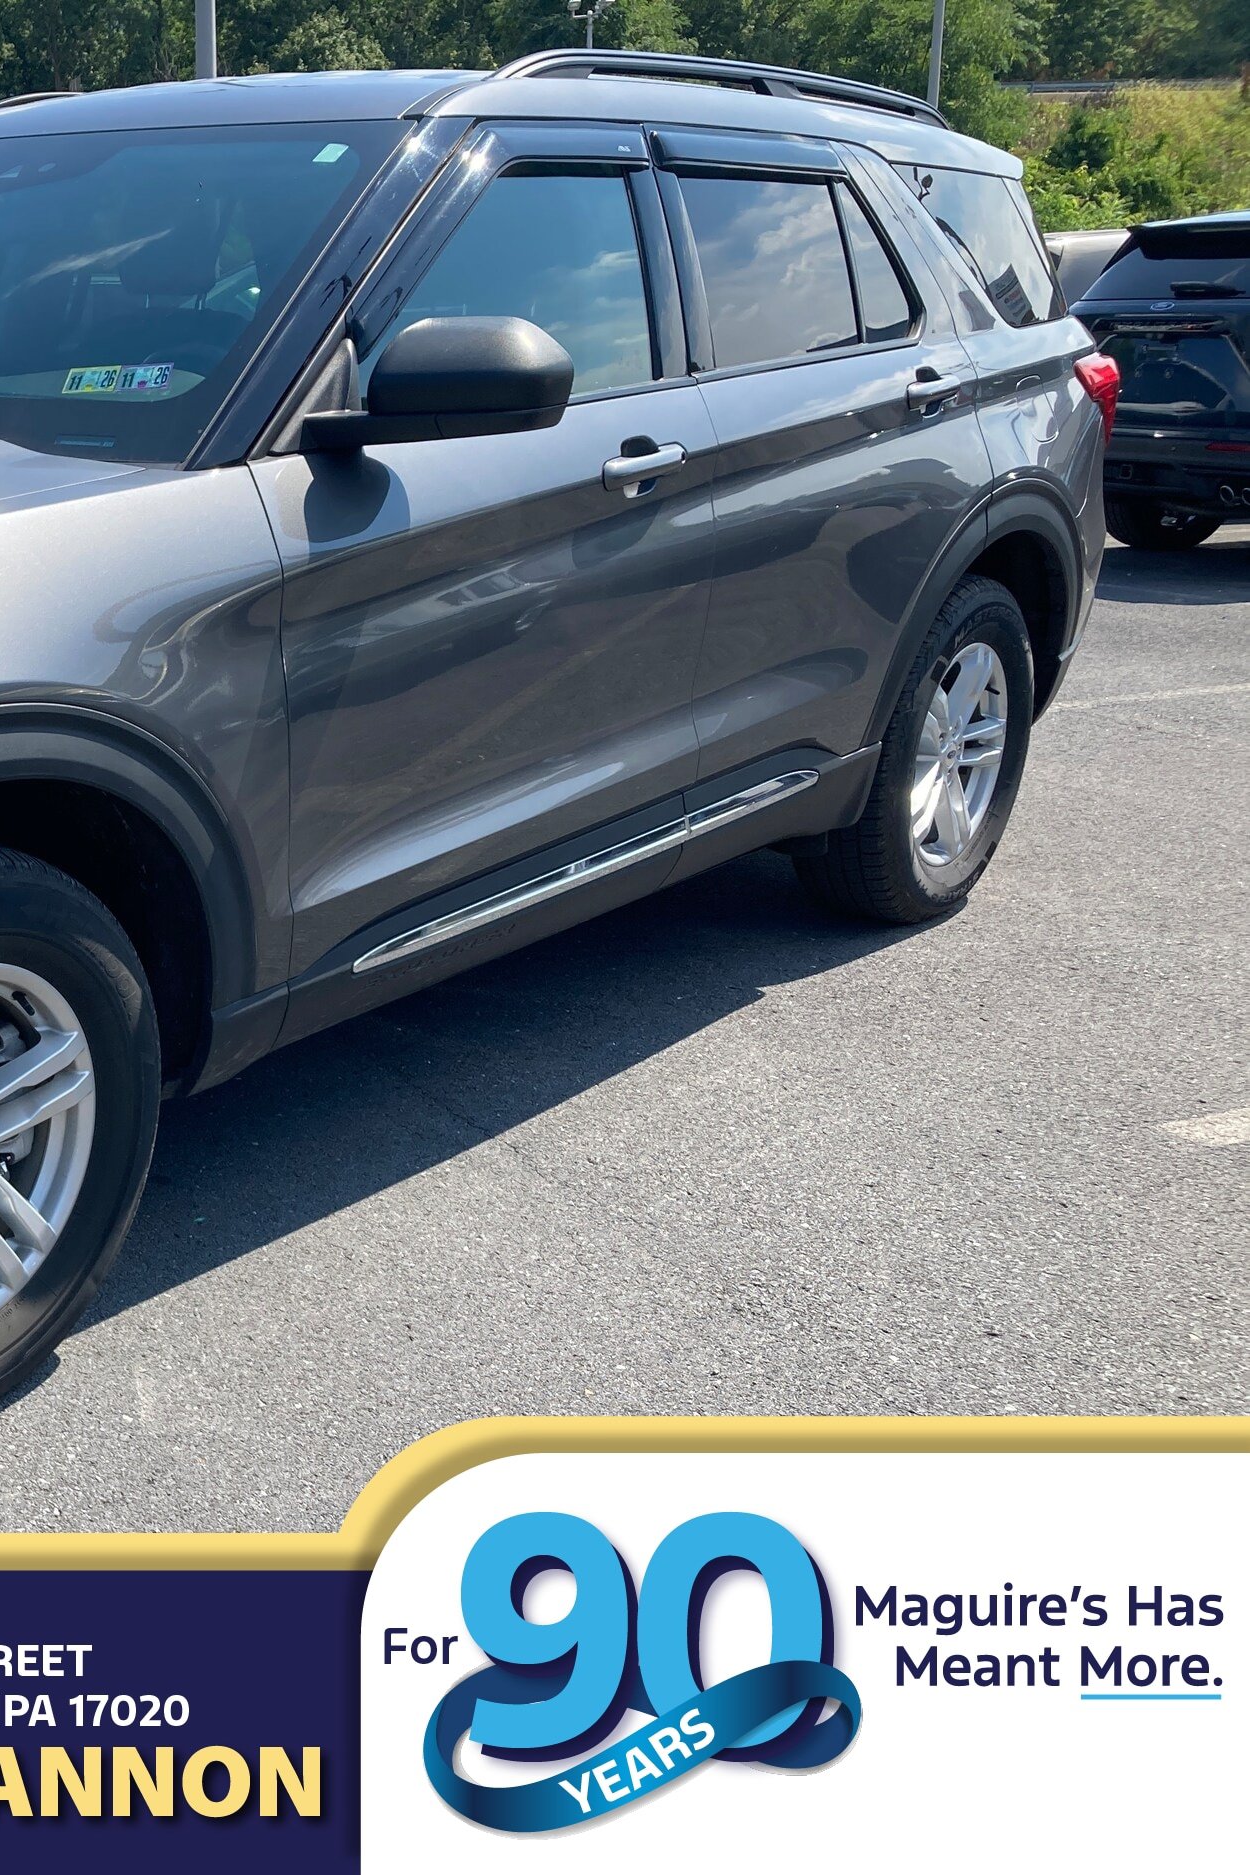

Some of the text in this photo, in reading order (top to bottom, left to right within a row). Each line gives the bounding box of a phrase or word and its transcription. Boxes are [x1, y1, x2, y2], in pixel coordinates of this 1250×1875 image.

[69, 371, 117, 390] 11 26
[121, 366, 170, 388] 11 26
